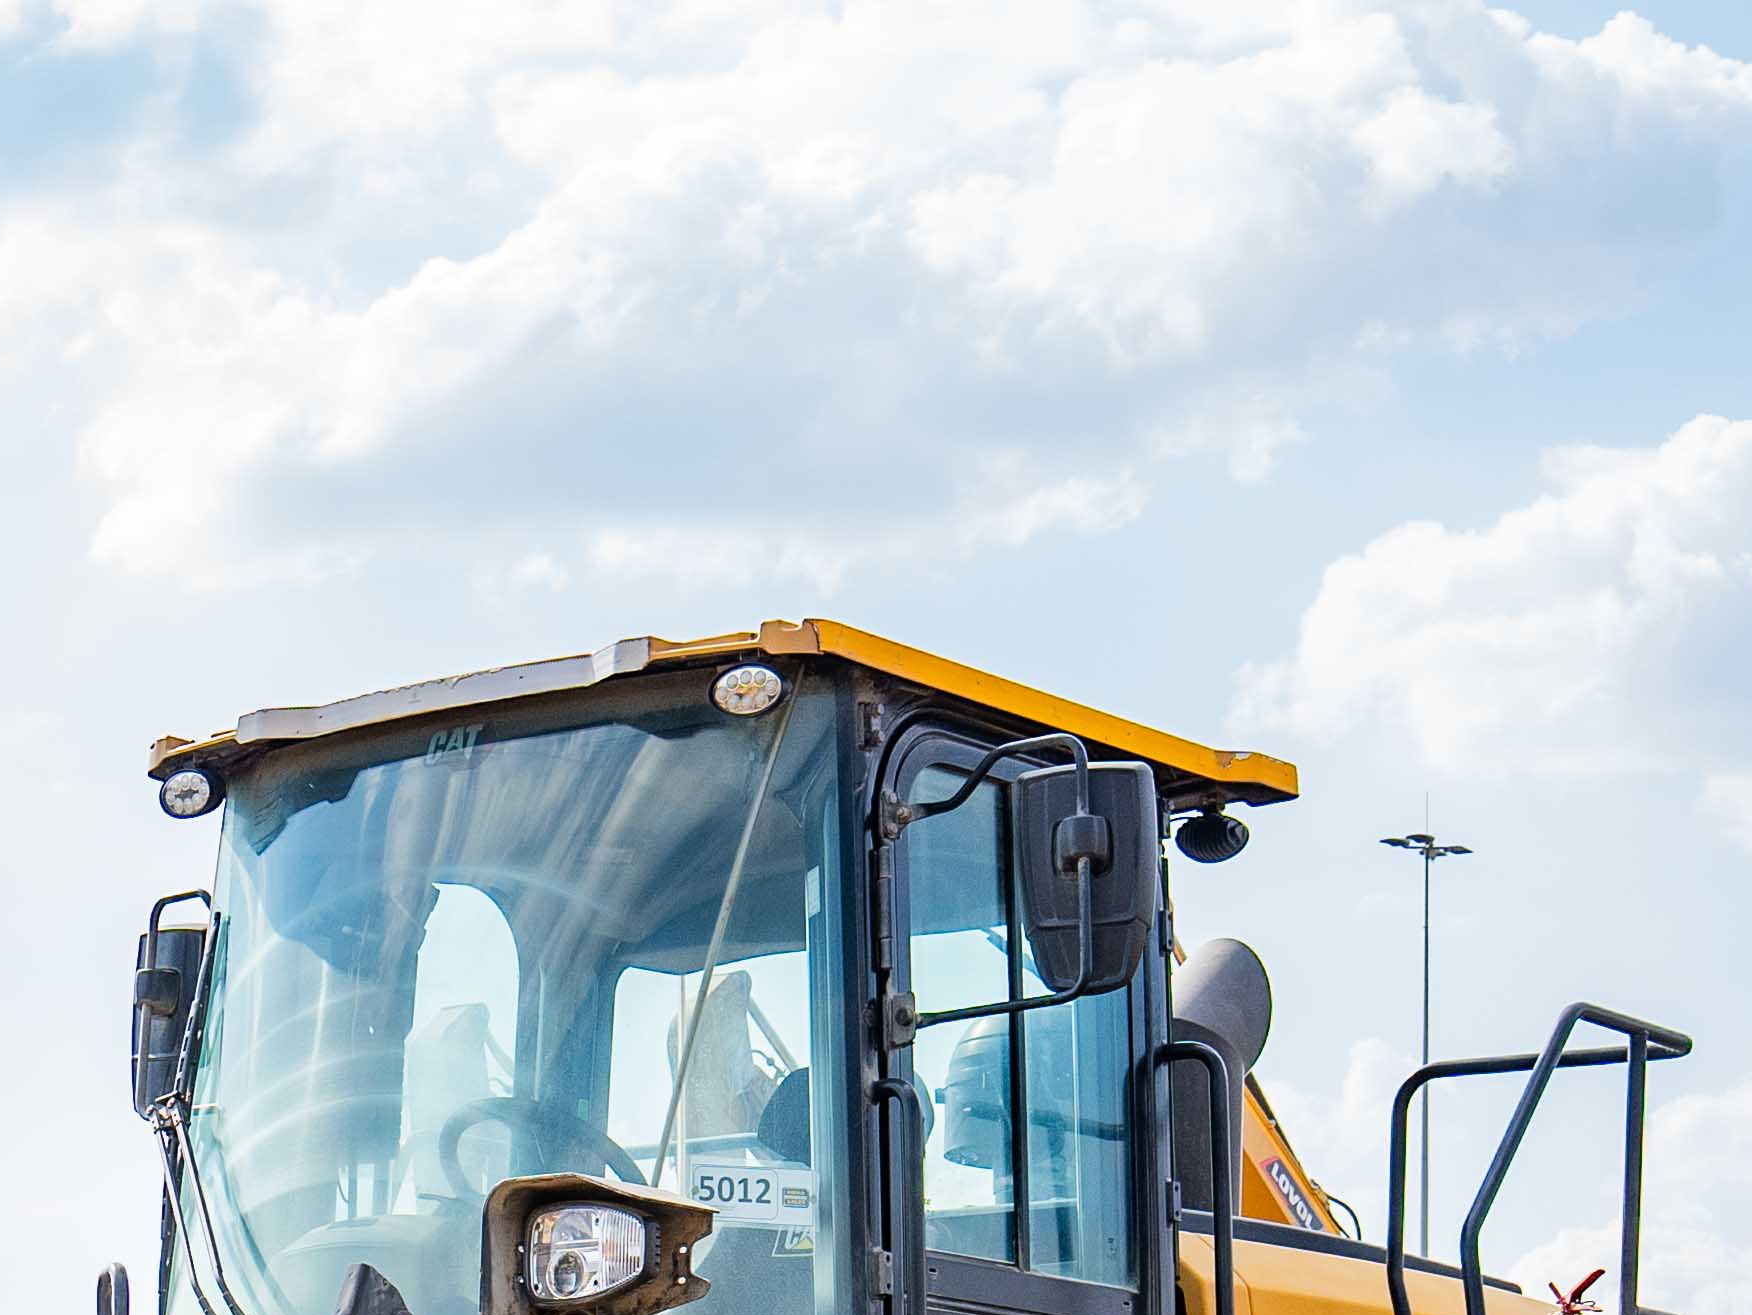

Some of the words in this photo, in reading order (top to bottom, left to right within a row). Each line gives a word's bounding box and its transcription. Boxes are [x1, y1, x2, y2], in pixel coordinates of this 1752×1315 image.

[424, 724, 484, 766] CAT
[699, 1175, 771, 1204] 5012
[1271, 1161, 1314, 1231] LOVOL
